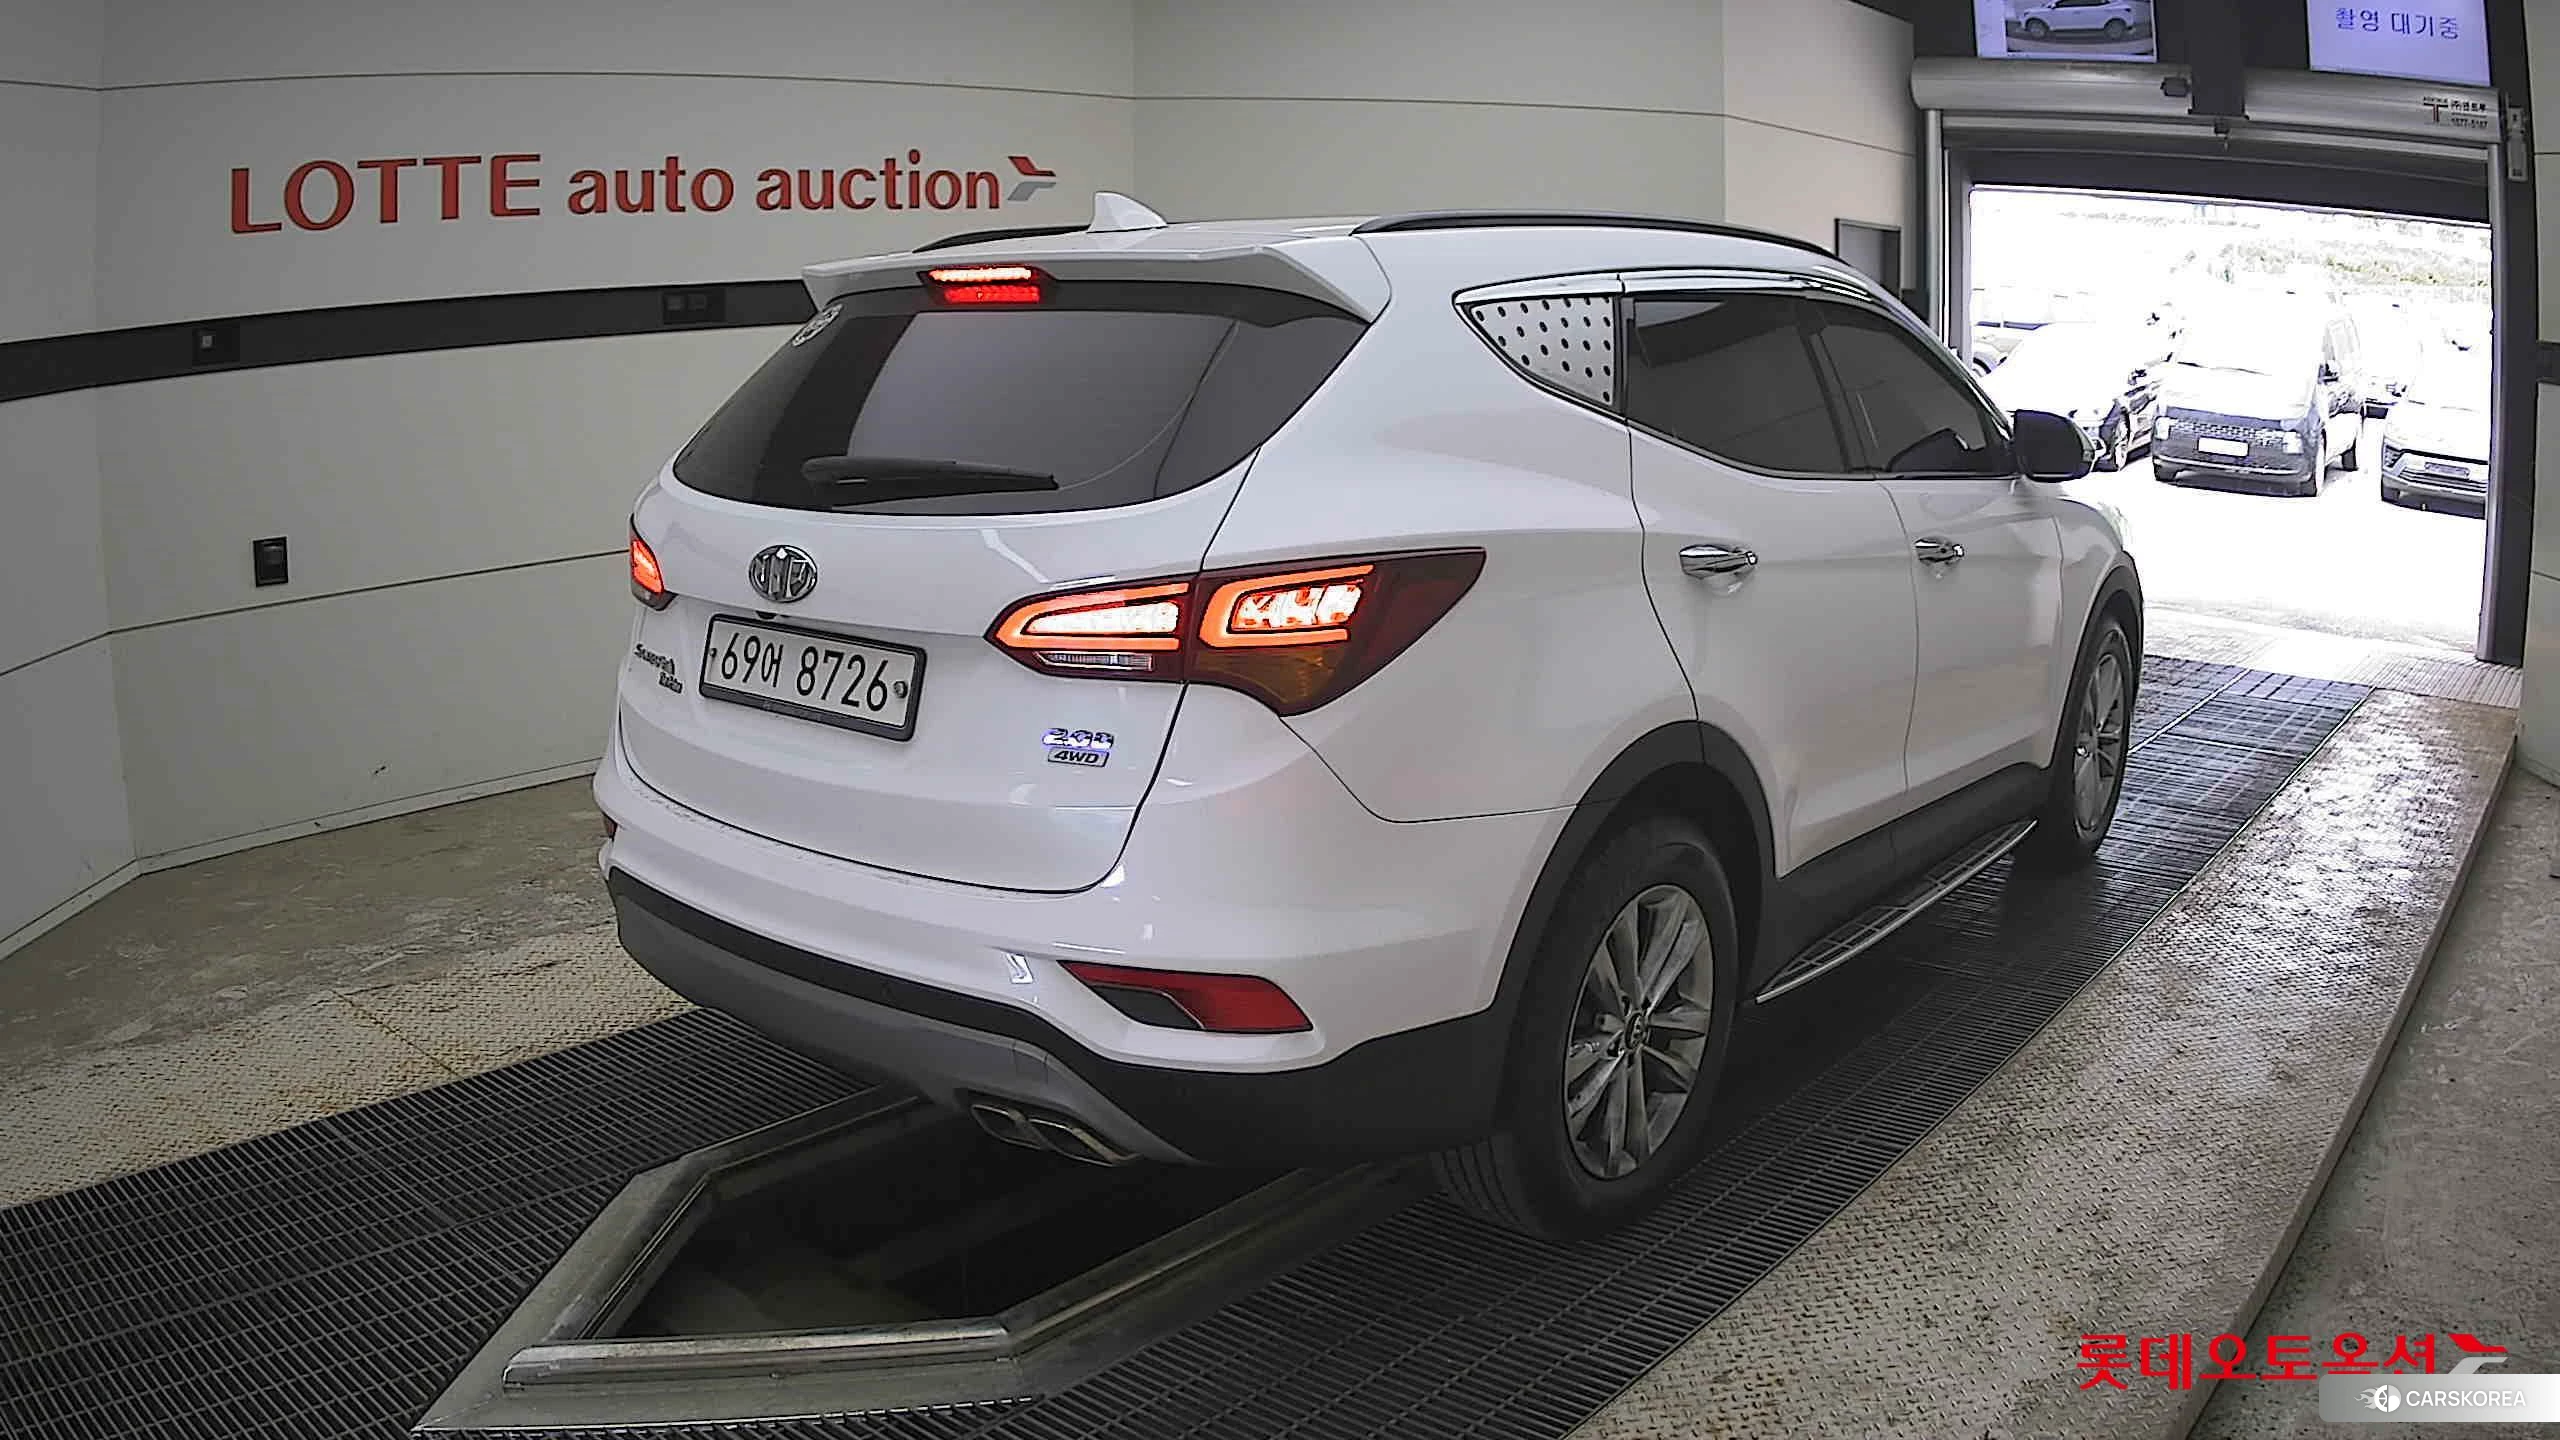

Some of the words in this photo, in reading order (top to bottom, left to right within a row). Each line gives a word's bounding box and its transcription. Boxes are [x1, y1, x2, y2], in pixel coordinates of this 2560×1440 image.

[2391, 12, 2459, 40] 대기중
[230, 154, 541, 233] LOTTE
[568, 158, 735, 213] auto
[756, 149, 1001, 211] auction
[721, 632, 784, 688] 69어
[796, 646, 889, 711] 8726
[1053, 750, 1100, 764] 4WD
